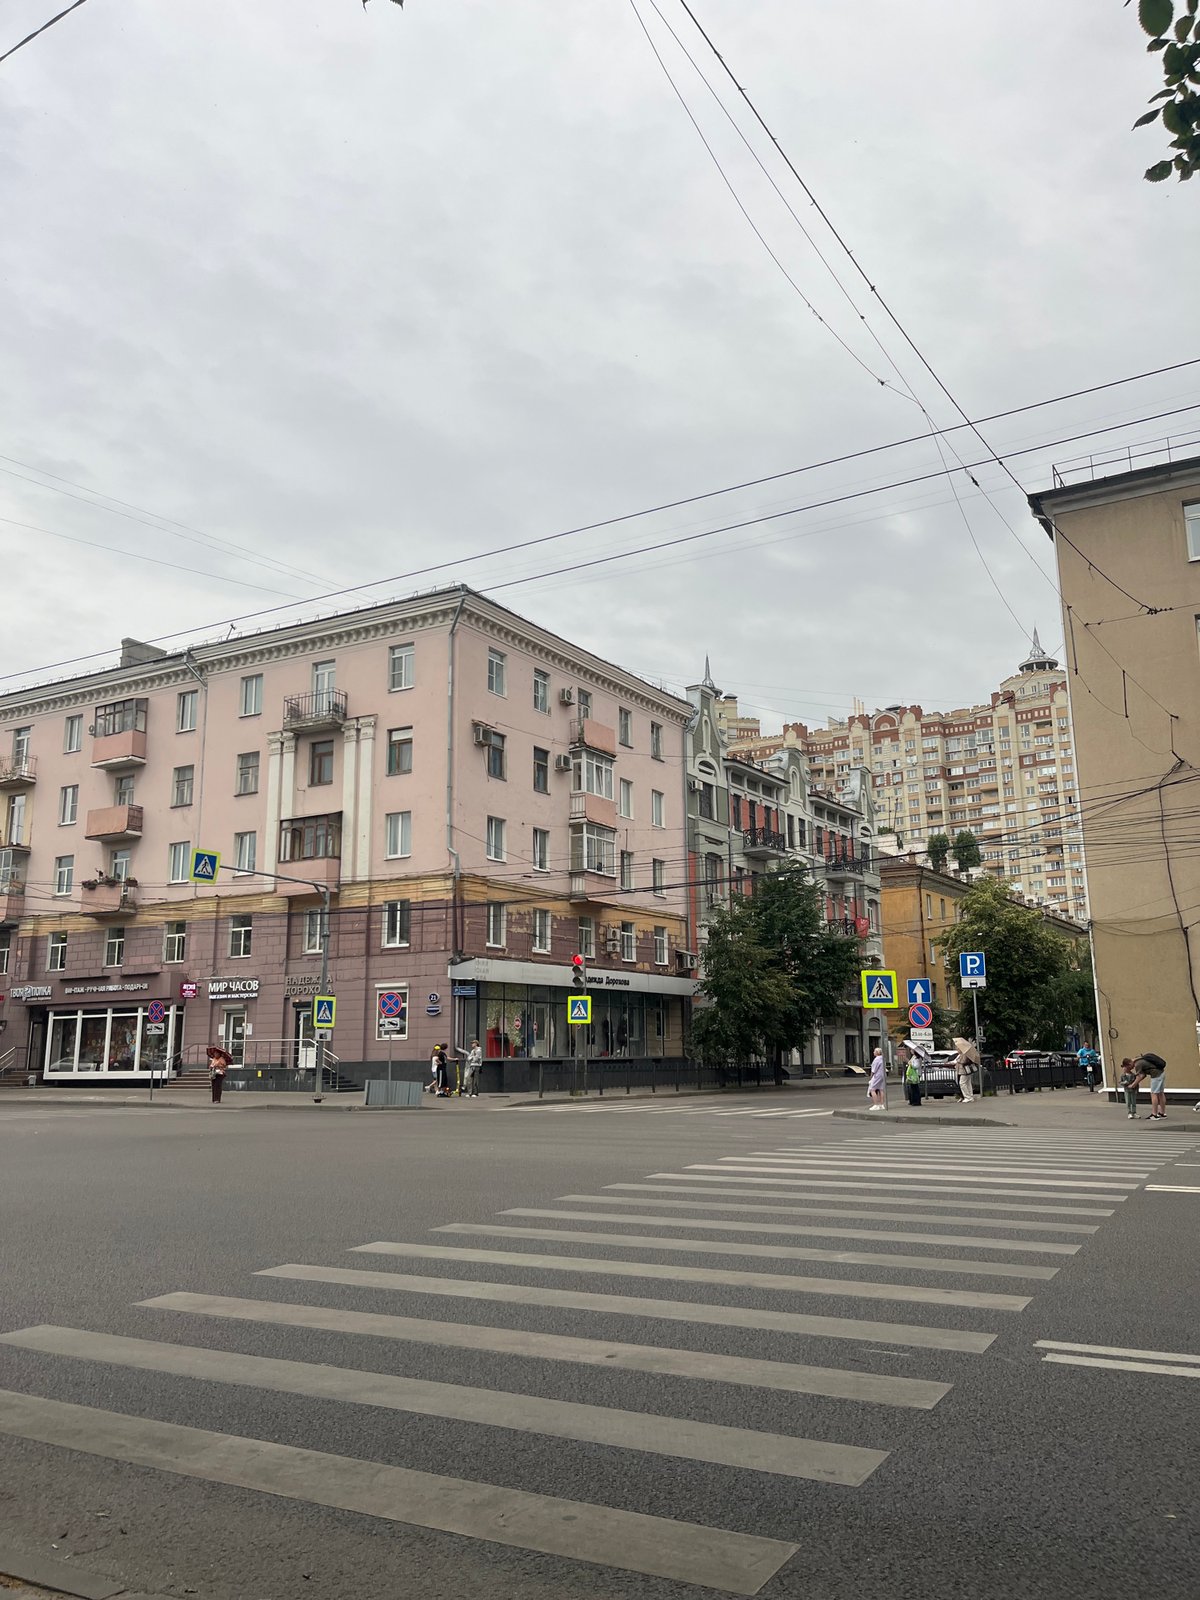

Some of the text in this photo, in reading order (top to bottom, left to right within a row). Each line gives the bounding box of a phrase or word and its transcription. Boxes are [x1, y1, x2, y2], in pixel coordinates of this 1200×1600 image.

[966, 955, 980, 974] P
[285, 974, 333, 984] НАДЕЖА
[208, 981, 227, 993] МИР
[229, 980, 259, 991] ЧАСОВ
[284, 985, 333, 997] ДОРОХОА
